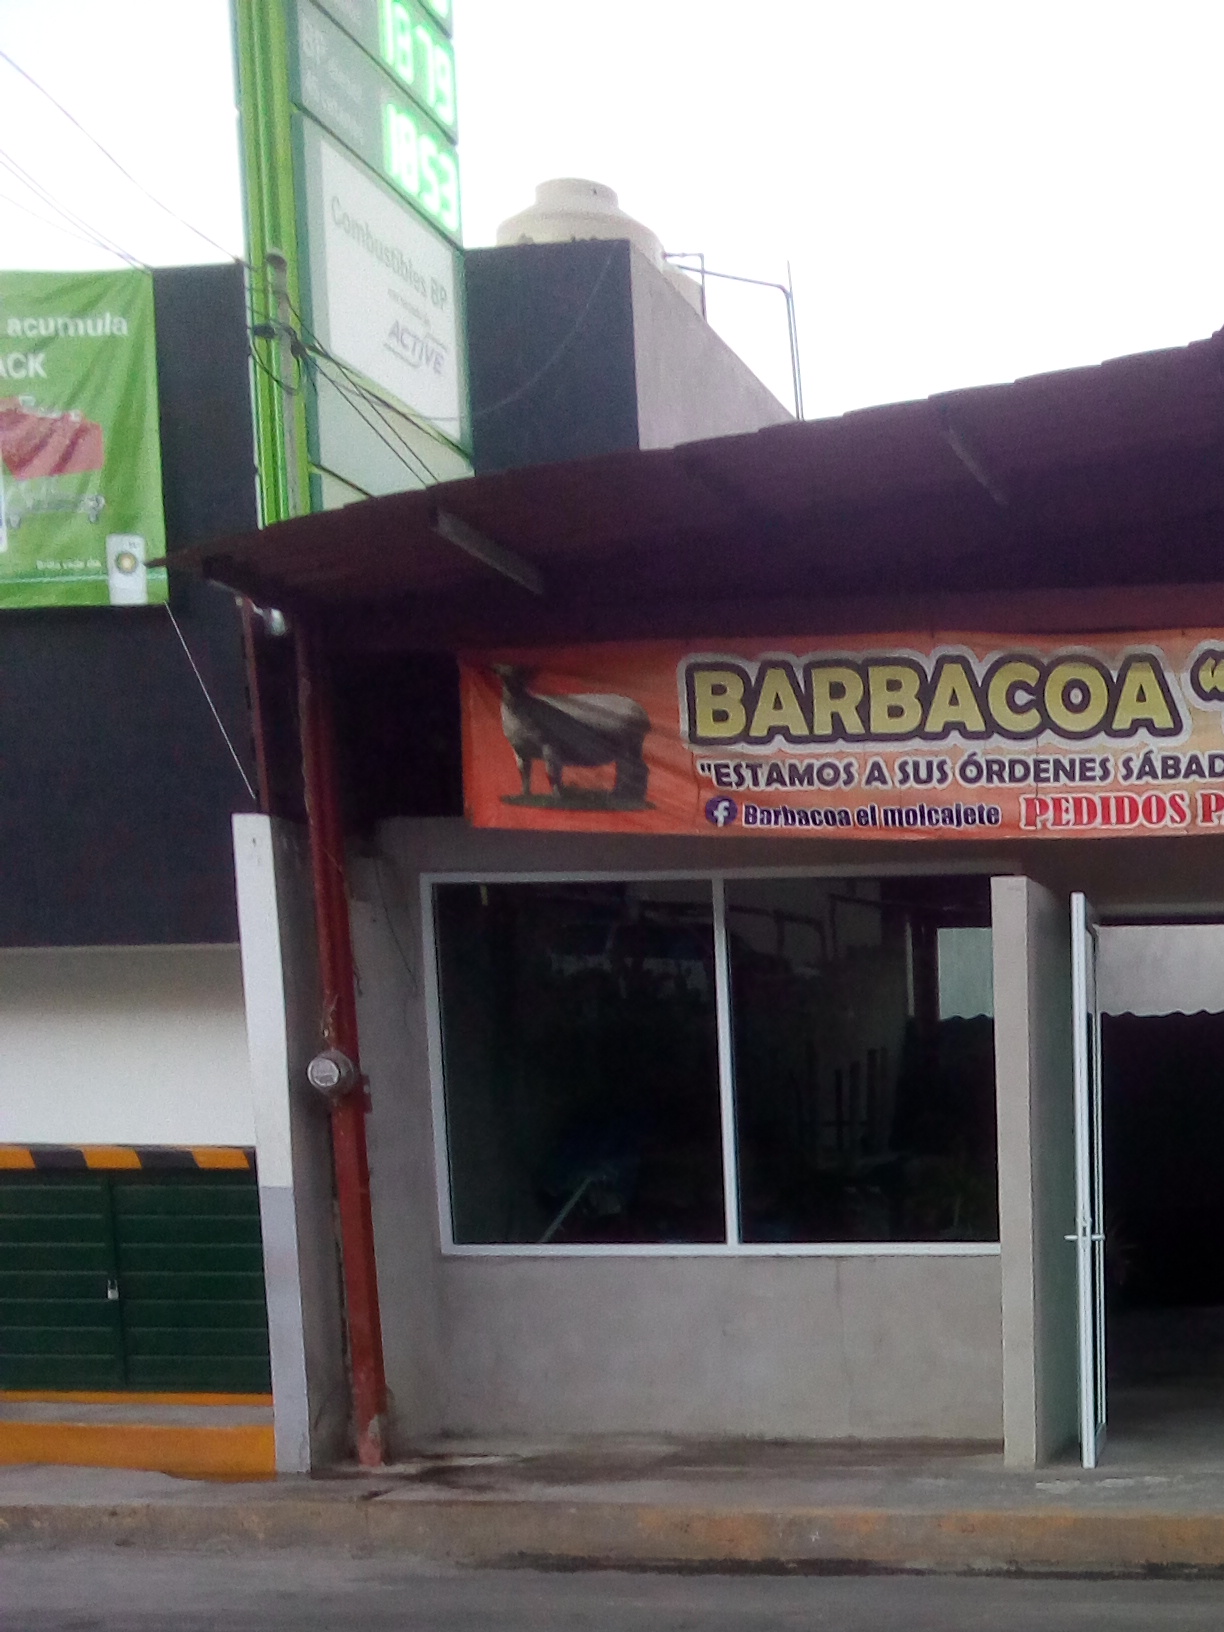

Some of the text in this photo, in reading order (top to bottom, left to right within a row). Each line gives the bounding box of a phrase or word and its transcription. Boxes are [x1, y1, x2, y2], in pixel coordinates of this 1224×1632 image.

[7, 312, 128, 337] acumula
[387, 319, 446, 375] ACTIVE
[688, 653, 1183, 744] BARBACOA
[866, 760, 888, 785] A
[898, 759, 948, 786] SUS
[959, 752, 1110, 784] ÓRDENES
[743, 803, 1000, 828] Barbacoa el molcajete
[1022, 793, 1187, 829] PEDIDOS
